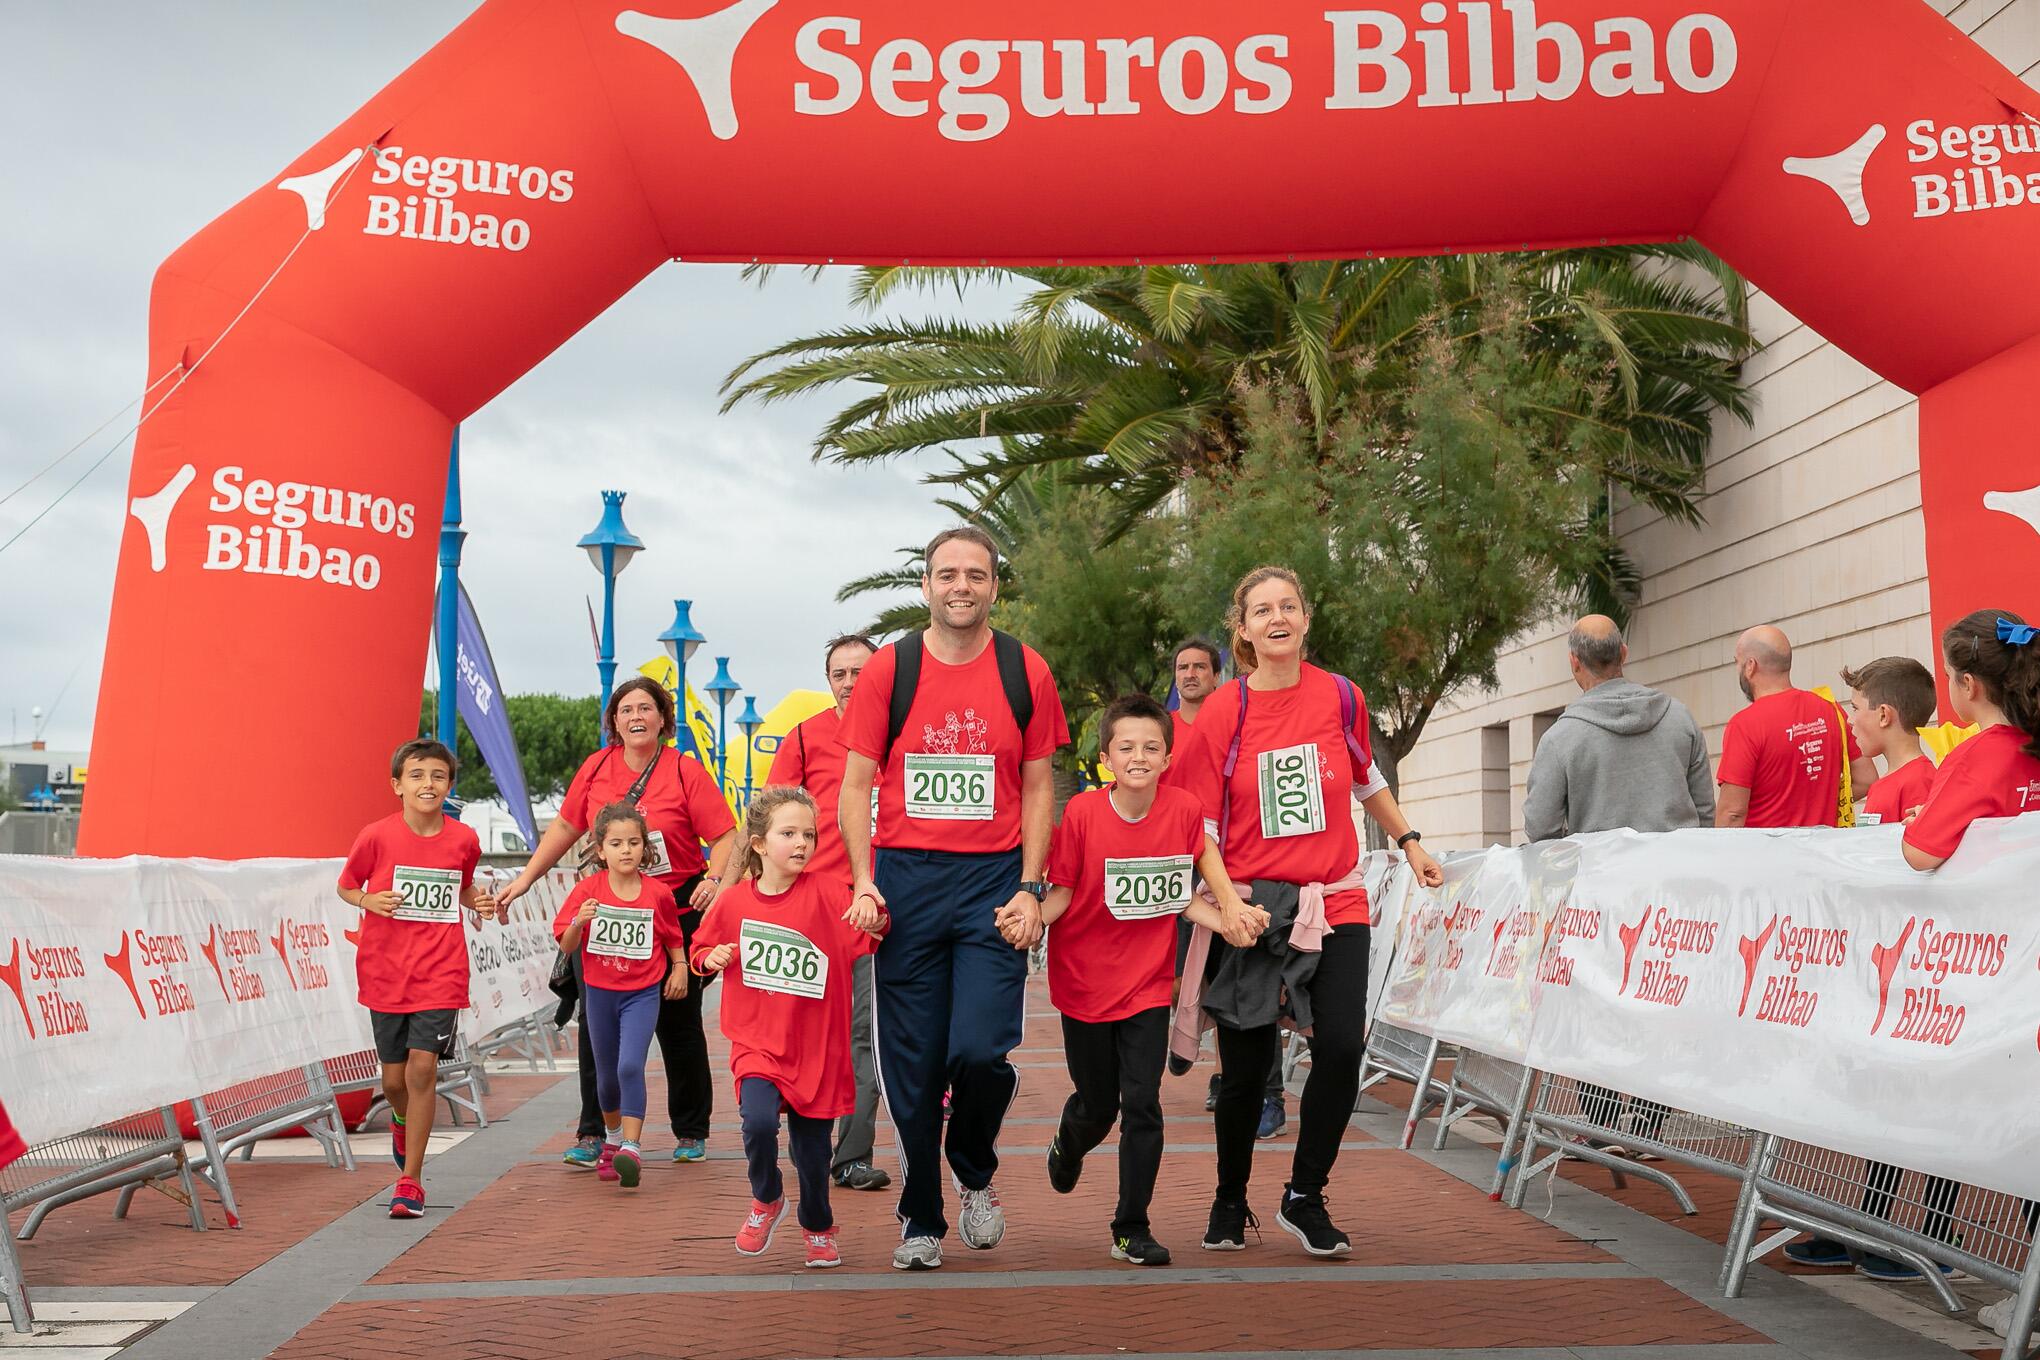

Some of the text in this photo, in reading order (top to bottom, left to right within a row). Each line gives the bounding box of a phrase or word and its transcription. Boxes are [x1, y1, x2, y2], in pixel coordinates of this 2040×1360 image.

[794, 0, 1738, 141] Seguros Bilbao
[371, 146, 574, 203] Seguros
[363, 195, 531, 251] Bilbao
[209, 465, 415, 539] Seguros
[203, 525, 381, 590] Bilbao
[913, 772, 985, 804] 2036
[1275, 755, 1310, 825] 2036
[401, 881, 453, 909] 2036
[1115, 871, 1183, 905] 2036
[218, 923, 261, 963] Seguros
[288, 917, 330, 955] Seguros
[596, 919, 646, 946] 2036
[1554, 900, 1600, 944] guros
[1648, 907, 1718, 959] Seguros
[1774, 915, 1849, 974] Seguros
[26, 938, 85, 988] Seguros
[135, 929, 188, 972] Seguros
[745, 940, 819, 981] 2036
[1910, 918, 2008, 985] Seguros
[148, 974, 196, 1016] Bilbao
[229, 966, 265, 1002] Bilbao
[1633, 959, 1688, 1007] Bilbao
[1755, 975, 1819, 1028] Bilbao
[37, 991, 89, 1037] Bilbao
[1890, 986, 1966, 1046] Bilbao
